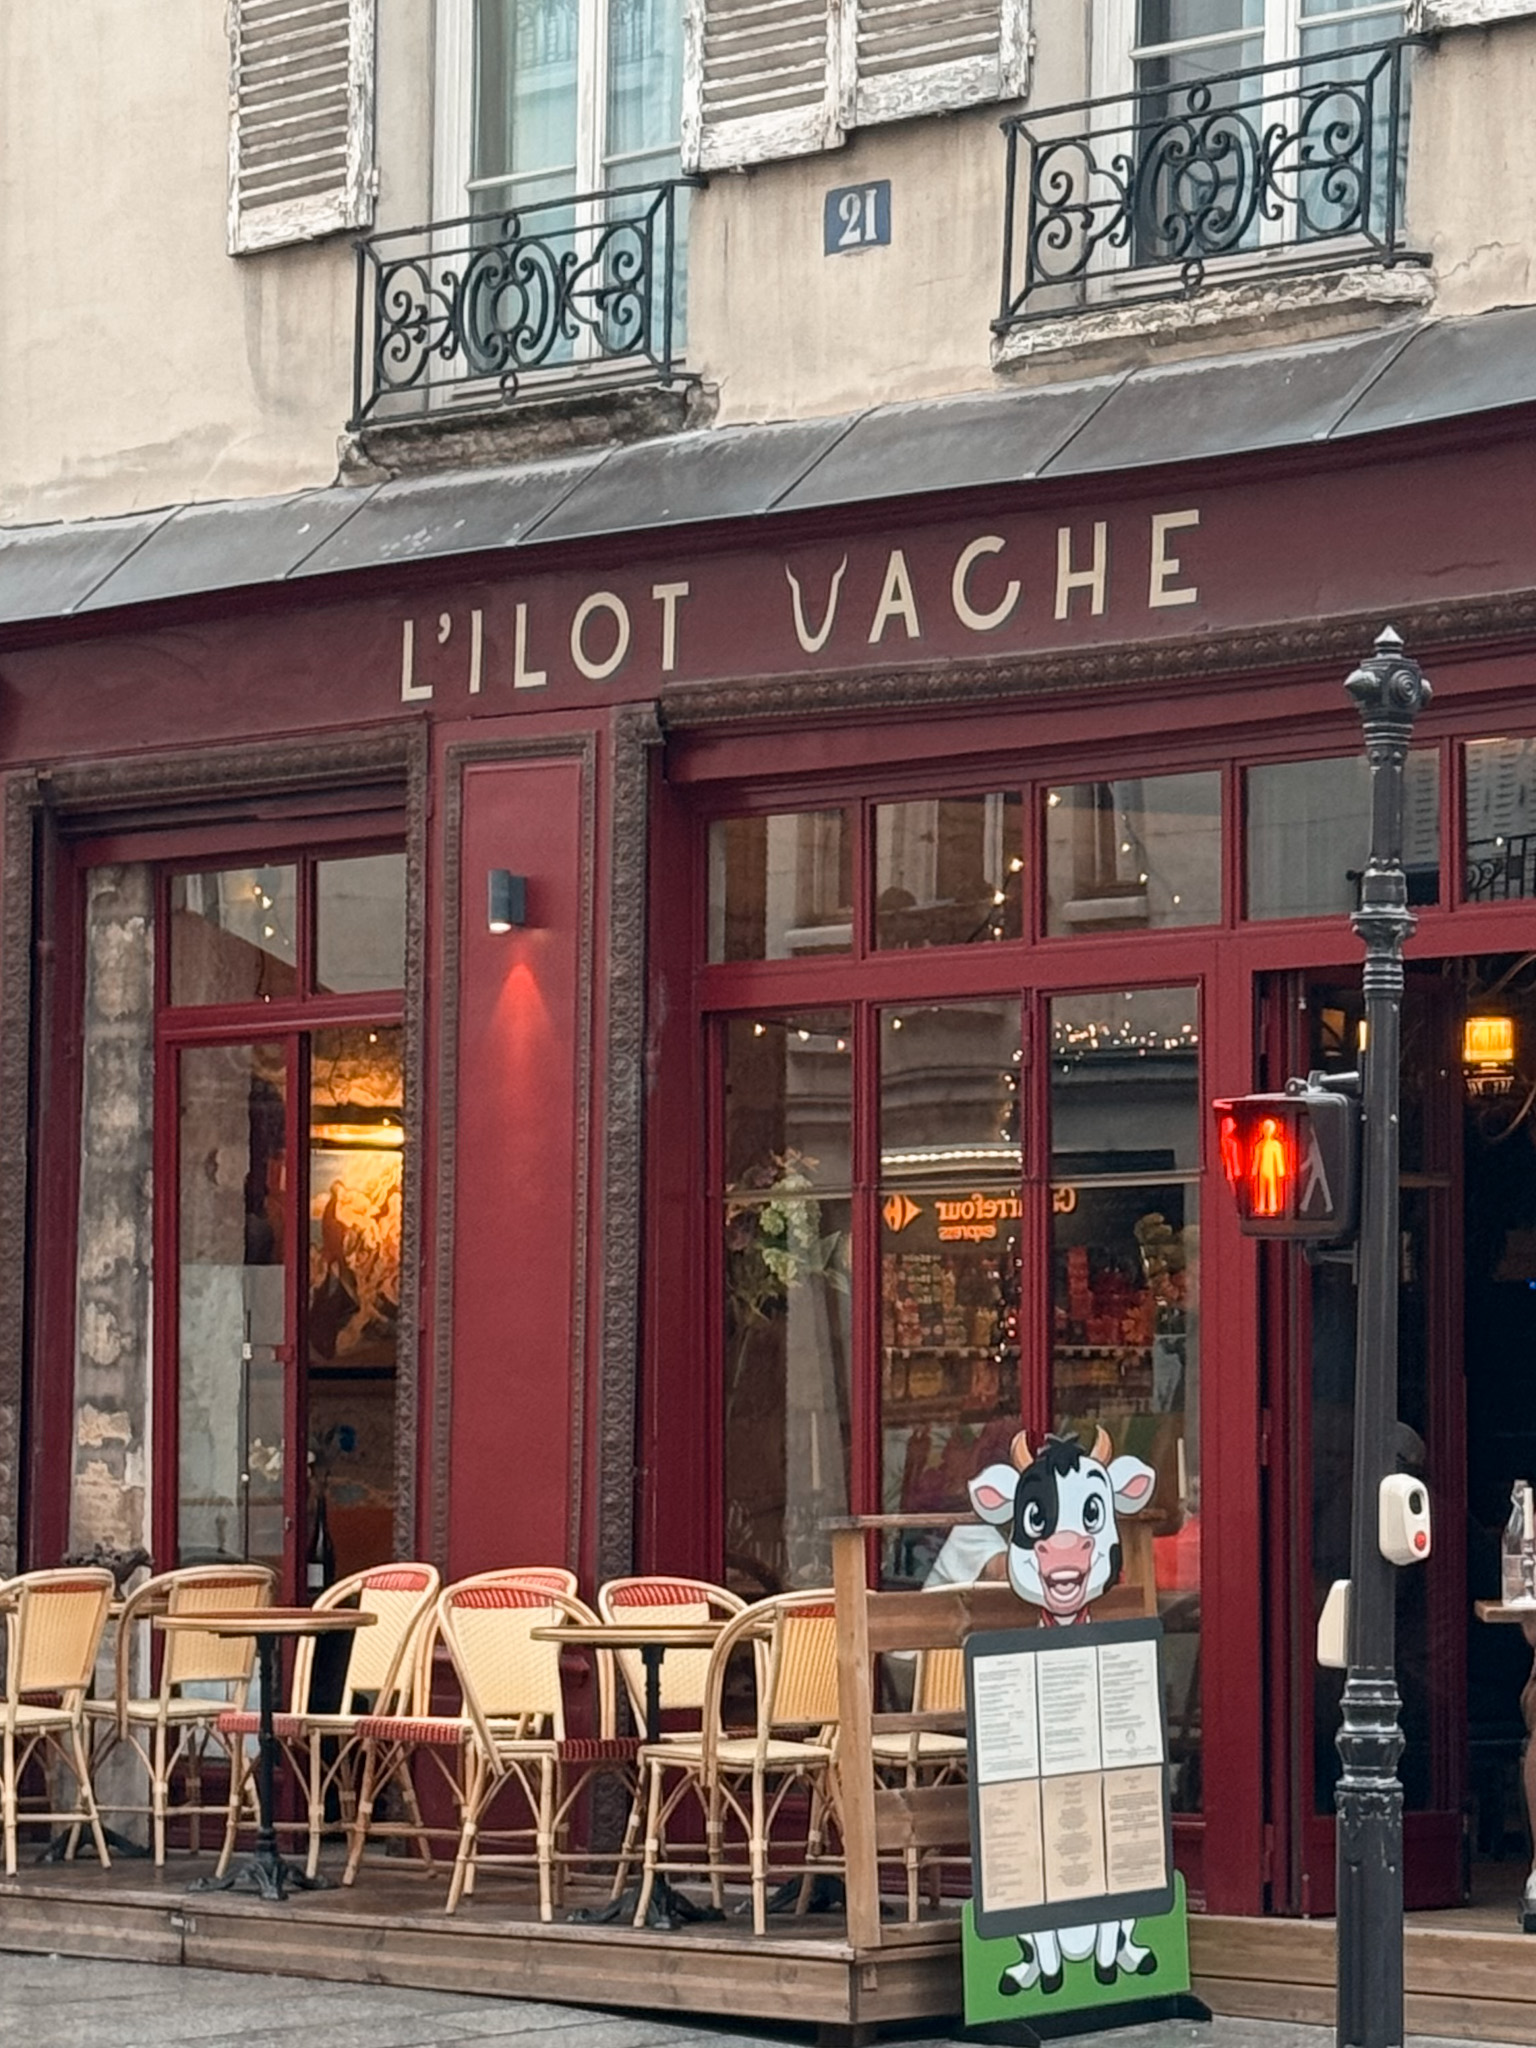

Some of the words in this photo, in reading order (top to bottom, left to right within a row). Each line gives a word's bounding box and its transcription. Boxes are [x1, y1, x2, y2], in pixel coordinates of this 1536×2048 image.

[838, 188, 878, 247] 21
[400, 581, 690, 702] L'ILOT
[784, 508, 1200, 654] VACHE
